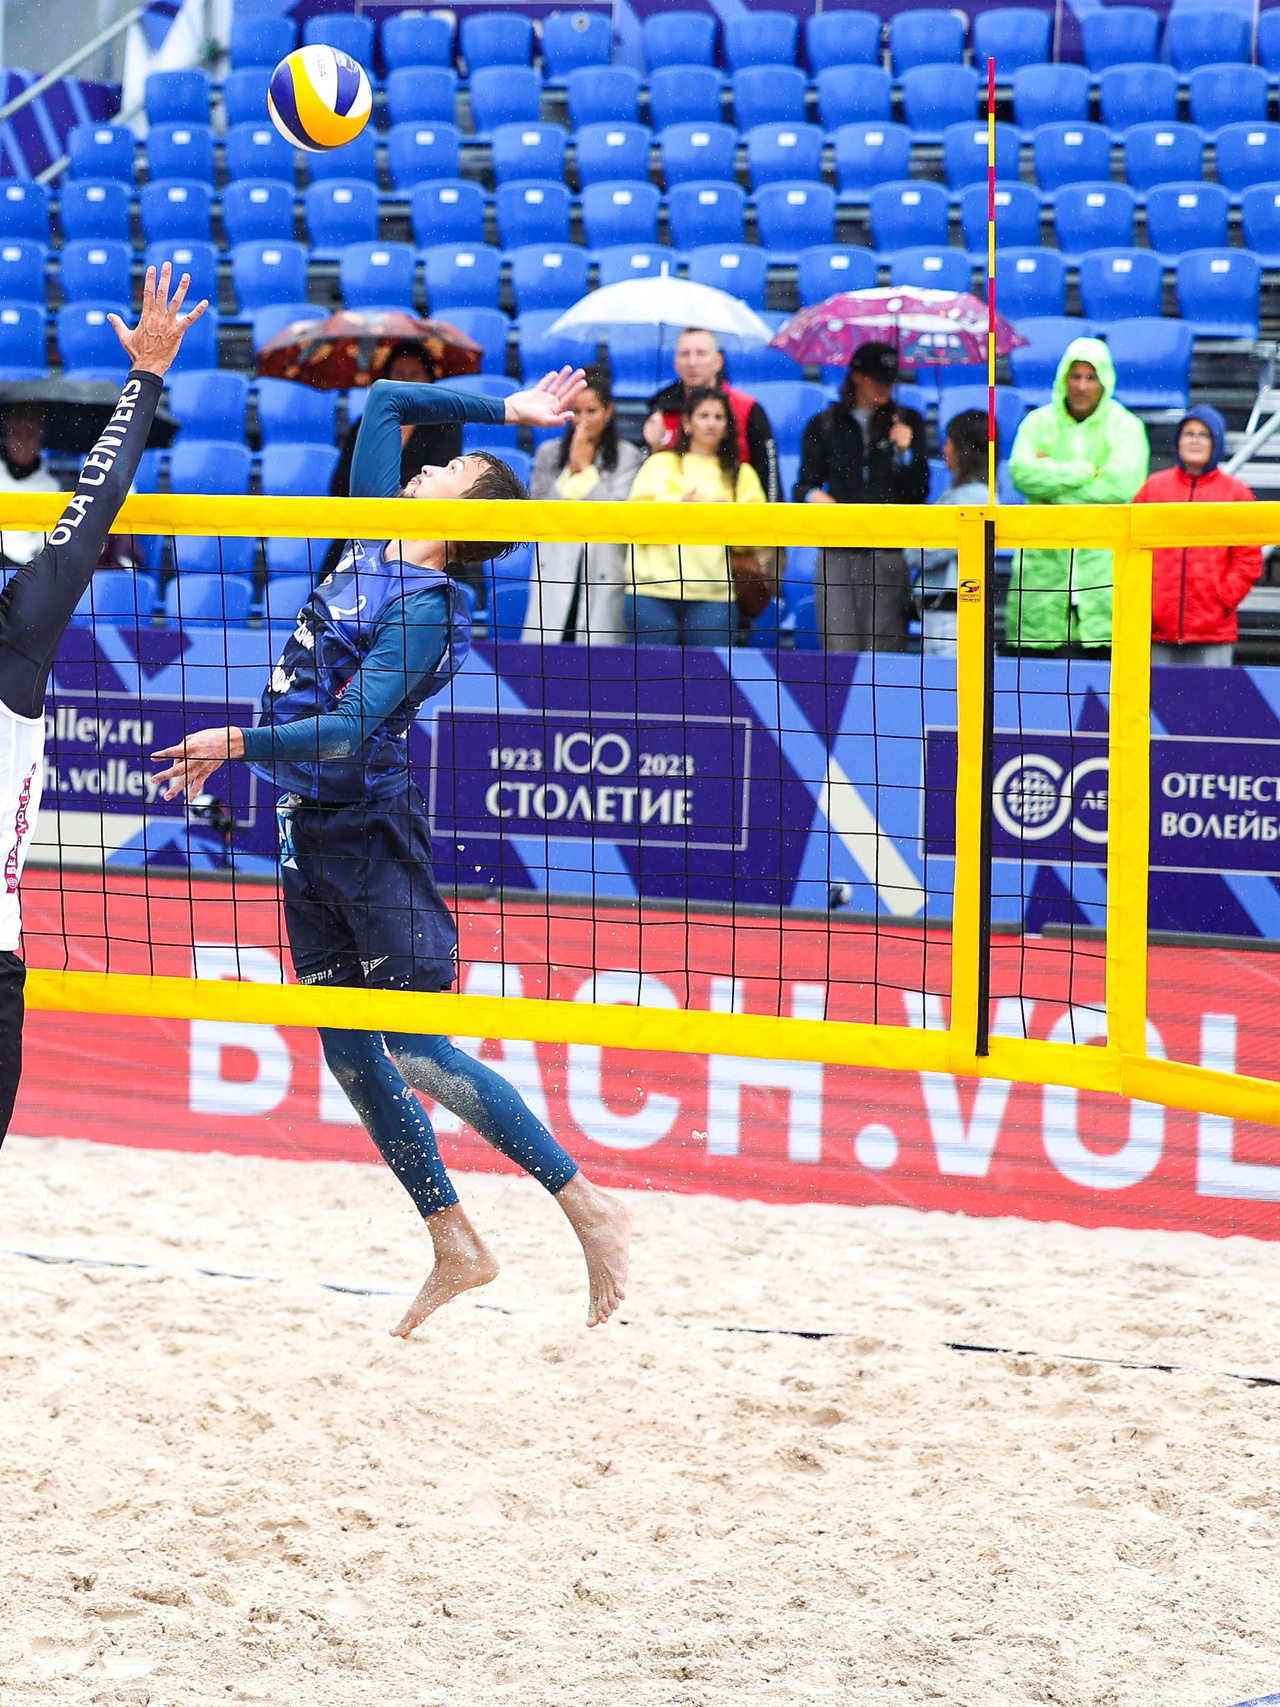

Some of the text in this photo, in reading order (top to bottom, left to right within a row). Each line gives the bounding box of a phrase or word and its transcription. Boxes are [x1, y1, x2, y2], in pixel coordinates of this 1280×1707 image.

[48, 379, 142, 546] OLA CENTERS
[489, 732, 694, 777] 1923 100 2023
[485, 780, 694, 825] СТОЛЕТИЕ
[1161, 809, 1280, 841] ВОЛЕЙБ
[188, 942, 1280, 1201] BACH.VOL
